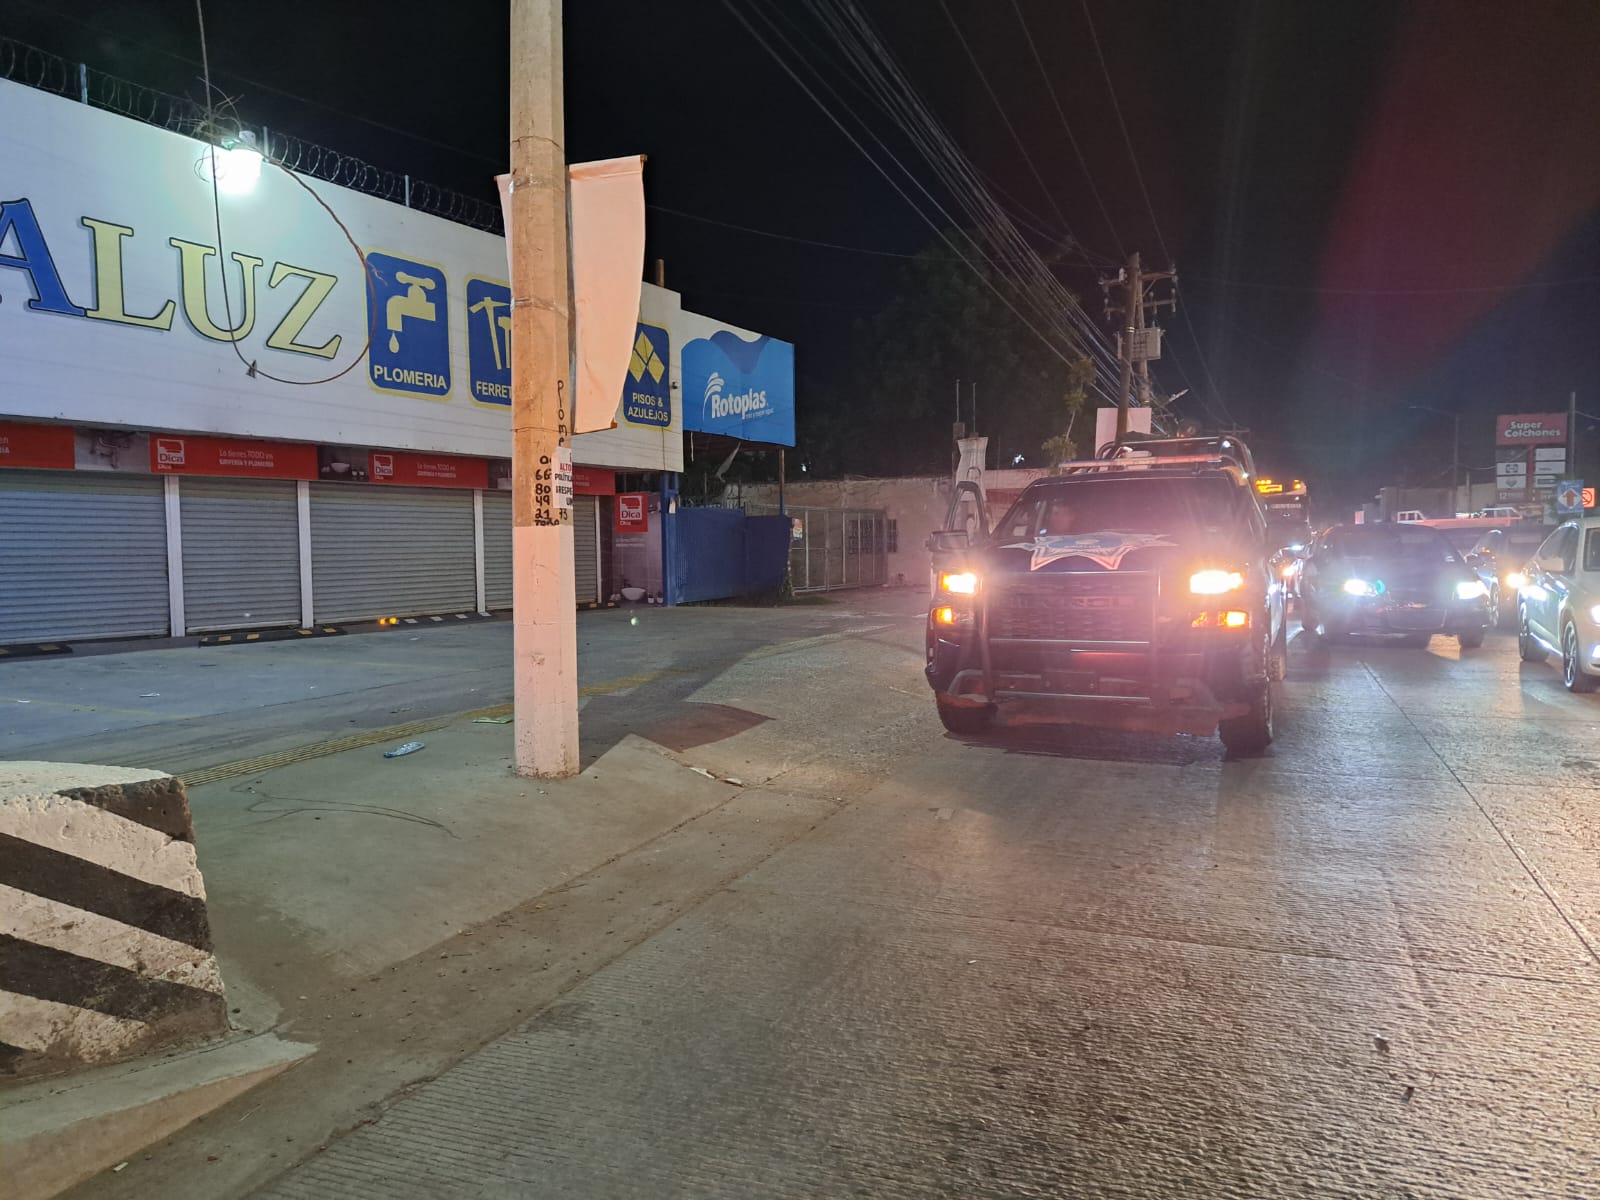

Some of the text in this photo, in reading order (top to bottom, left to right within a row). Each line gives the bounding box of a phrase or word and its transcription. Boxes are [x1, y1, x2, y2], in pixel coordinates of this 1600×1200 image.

[373, 365, 448, 389] PLOMERIA
[632, 392, 663, 407] PISOS &
[711, 388, 767, 419] Rotoplas
[627, 408, 669, 422] AZULEJOS
[1510, 421, 1542, 430] Super
[1504, 429, 1561, 438] Colchones
[159, 453, 184, 463] Dica
[621, 510, 641, 519] Dica
